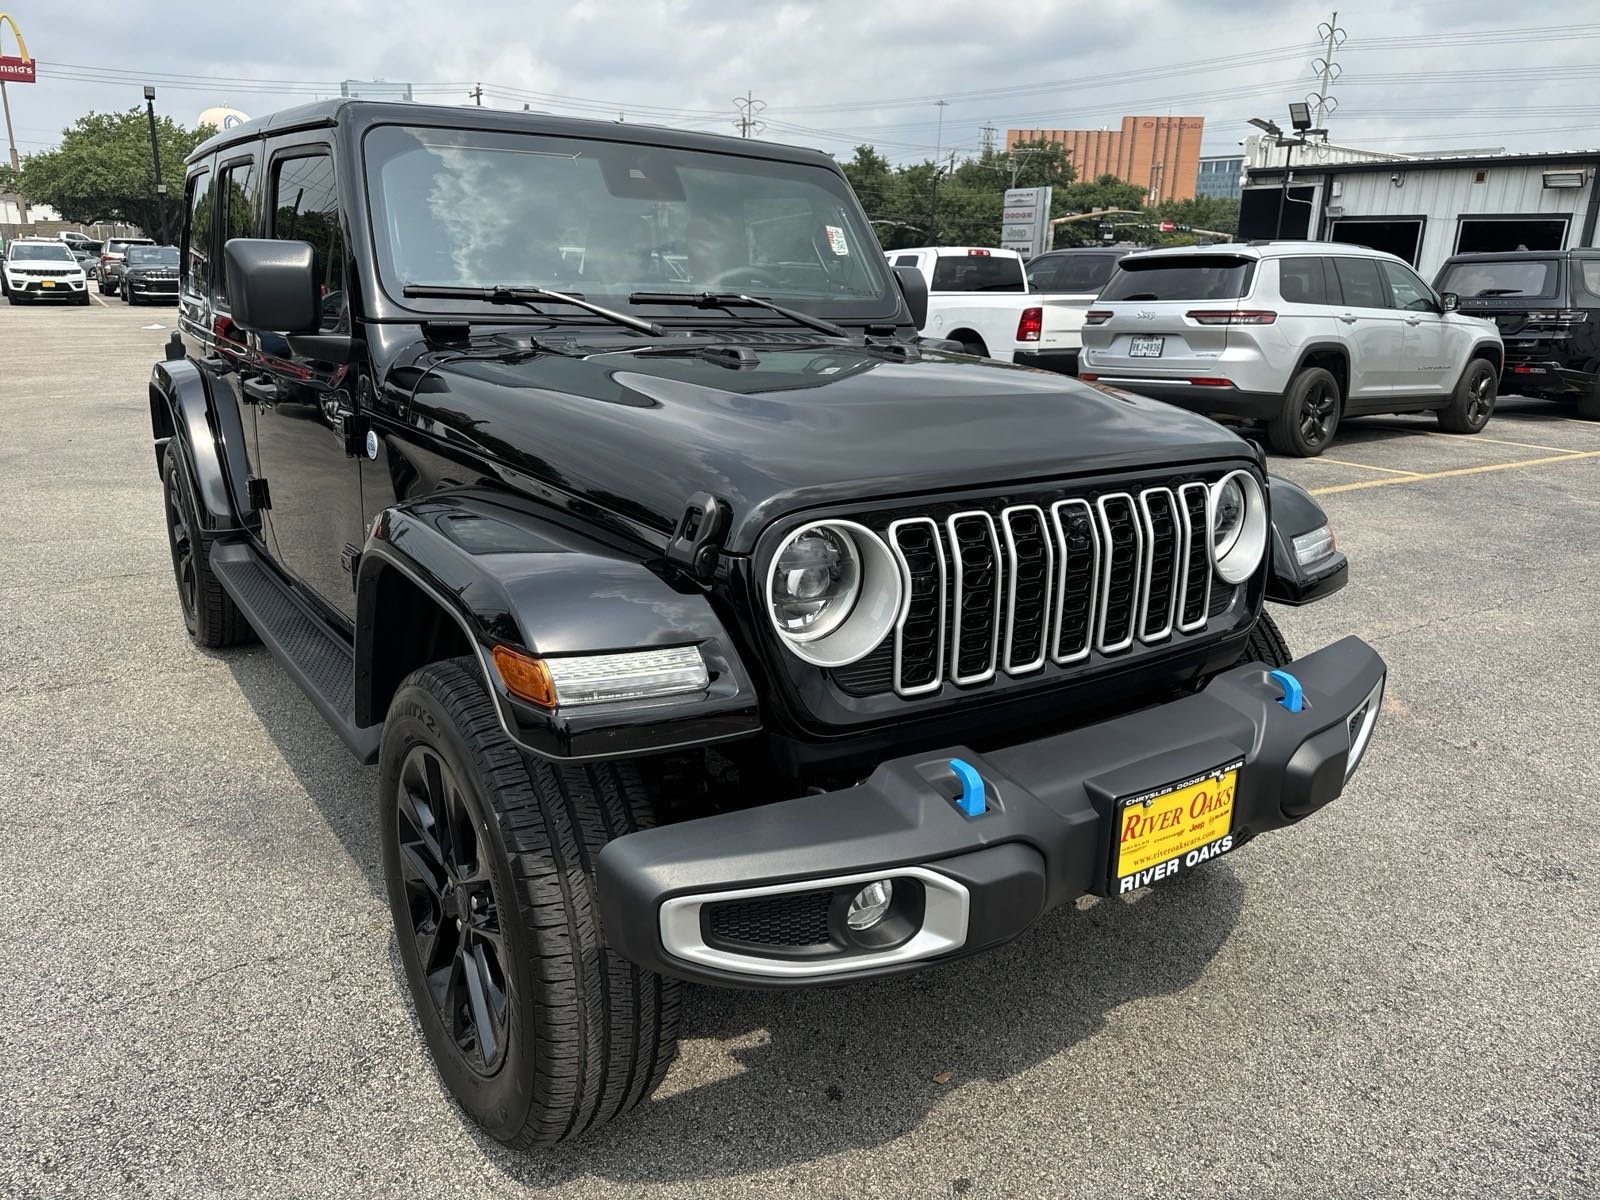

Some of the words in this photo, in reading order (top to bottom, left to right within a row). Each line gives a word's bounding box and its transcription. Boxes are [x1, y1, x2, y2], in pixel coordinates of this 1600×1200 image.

[1007, 226, 1026, 239] Jeep
[1136, 311, 1156, 320] Jeep
[1126, 787, 1173, 806] CHRYSLER
[1176, 776, 1206, 790] DODGE
[1224, 762, 1243, 773] RAM
[1120, 807, 1183, 843] RIVER
[1189, 786, 1233, 819] OAKS
[1189, 821, 1205, 833] Jeep
[1120, 858, 1180, 894] RIVER
[1185, 835, 1233, 867] OAKS
[1133, 830, 1216, 866] www.riveroakscars.com
